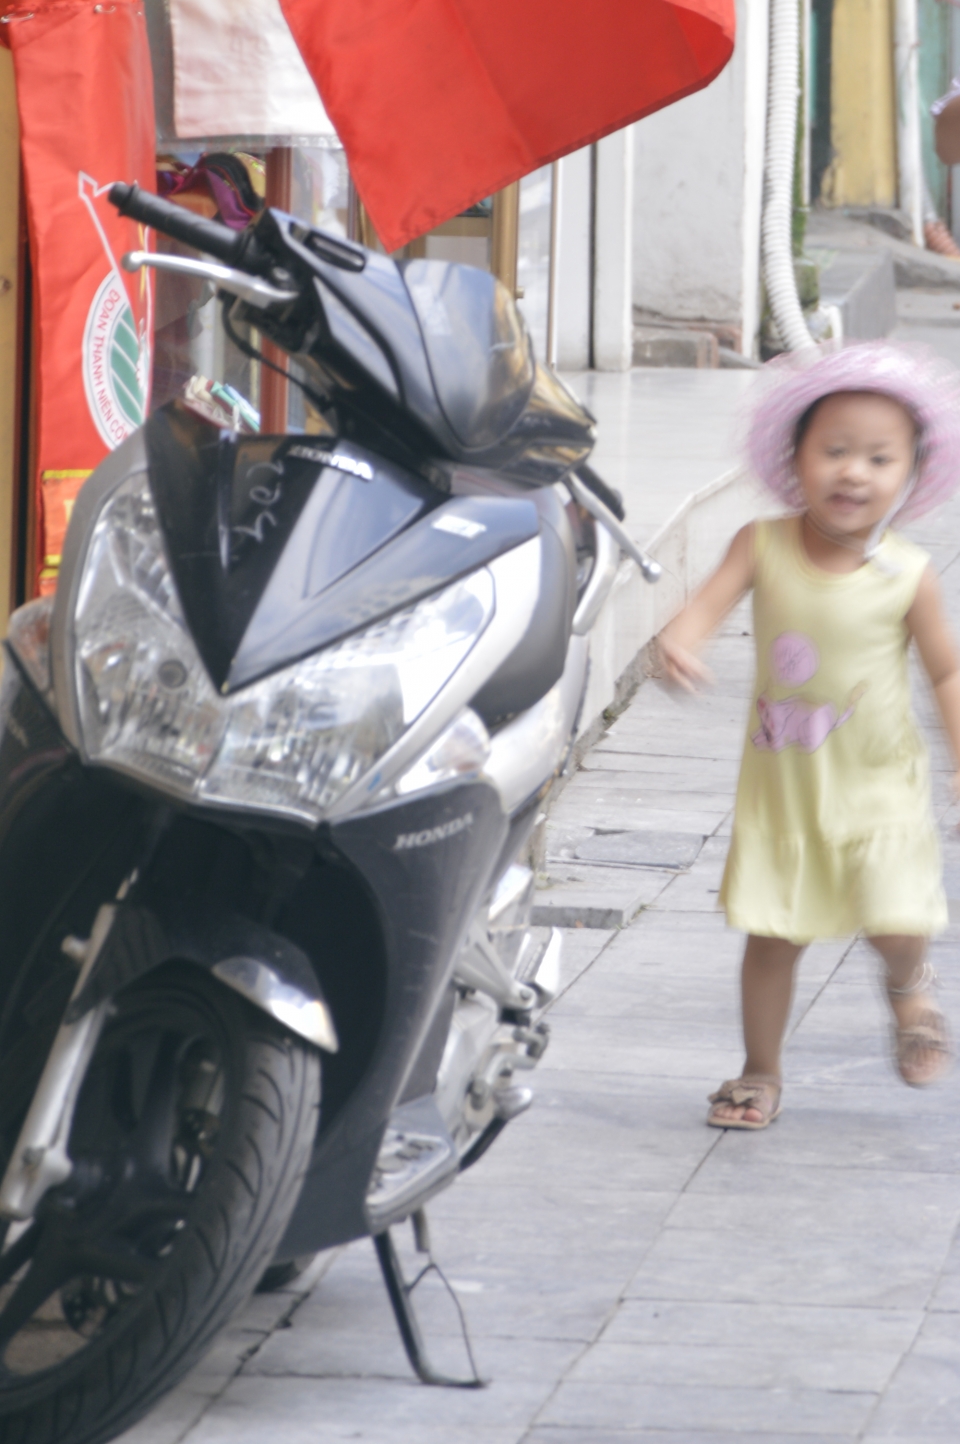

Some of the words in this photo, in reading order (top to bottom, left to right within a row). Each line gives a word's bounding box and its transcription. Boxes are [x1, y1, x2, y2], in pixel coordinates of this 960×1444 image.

[97, 289, 121, 331] ĐOÀN
[92, 335, 105, 386] THANH
[97, 388, 114, 422] NIÊN
[391, 811, 474, 852] HONDA
